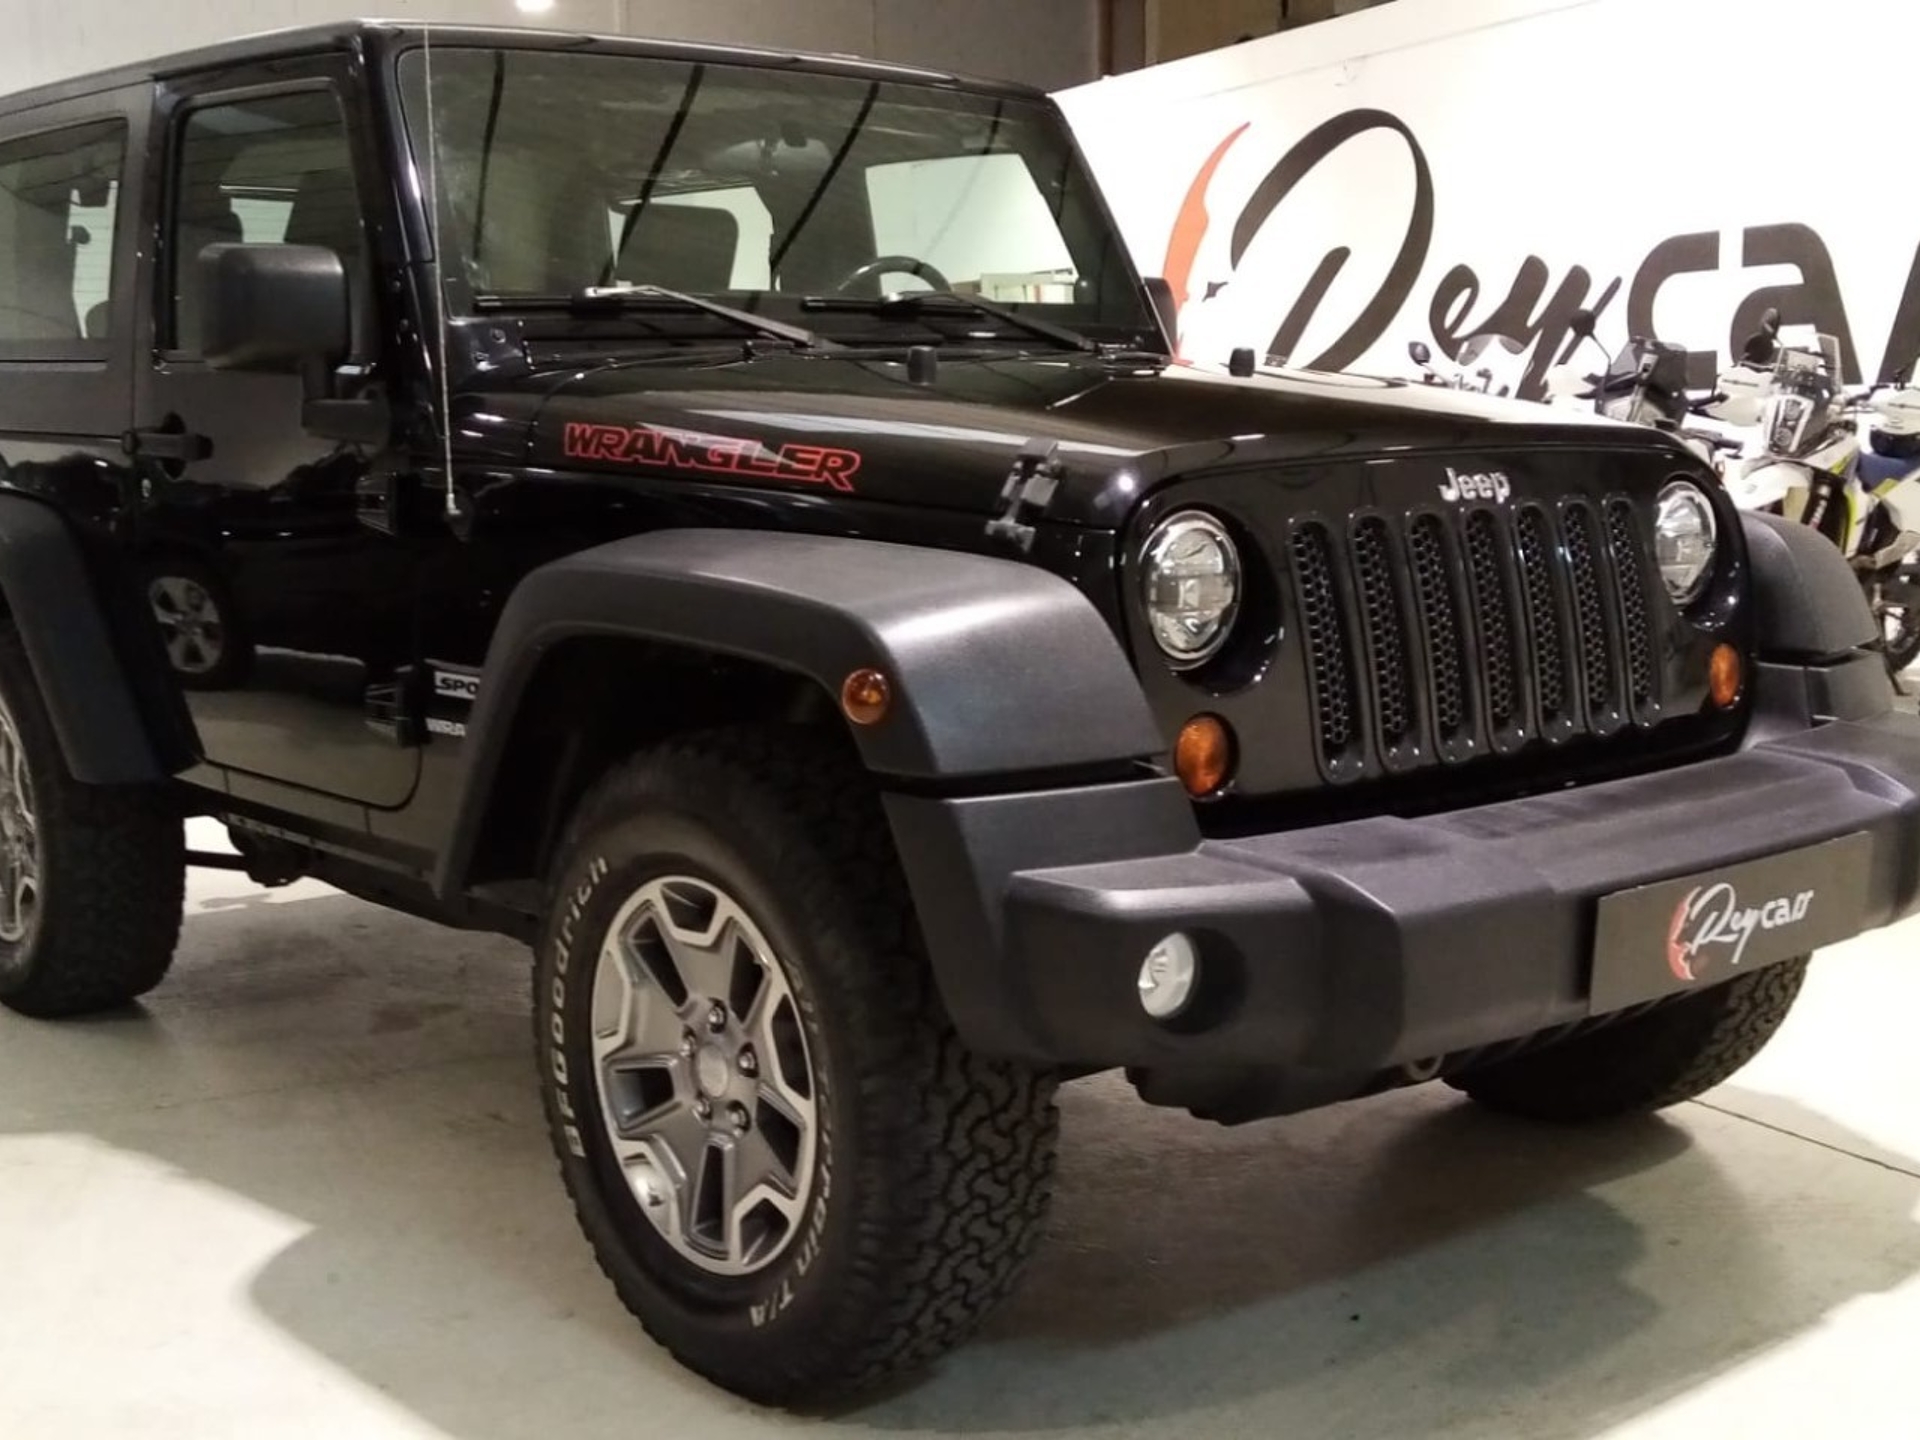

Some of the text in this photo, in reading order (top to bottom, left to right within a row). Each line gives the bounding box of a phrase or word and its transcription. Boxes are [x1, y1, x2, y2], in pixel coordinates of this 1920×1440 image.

[563, 422, 861, 491] WRANGLER
[1437, 467, 1511, 504] Jeep
[440, 677, 480, 696] SPO
